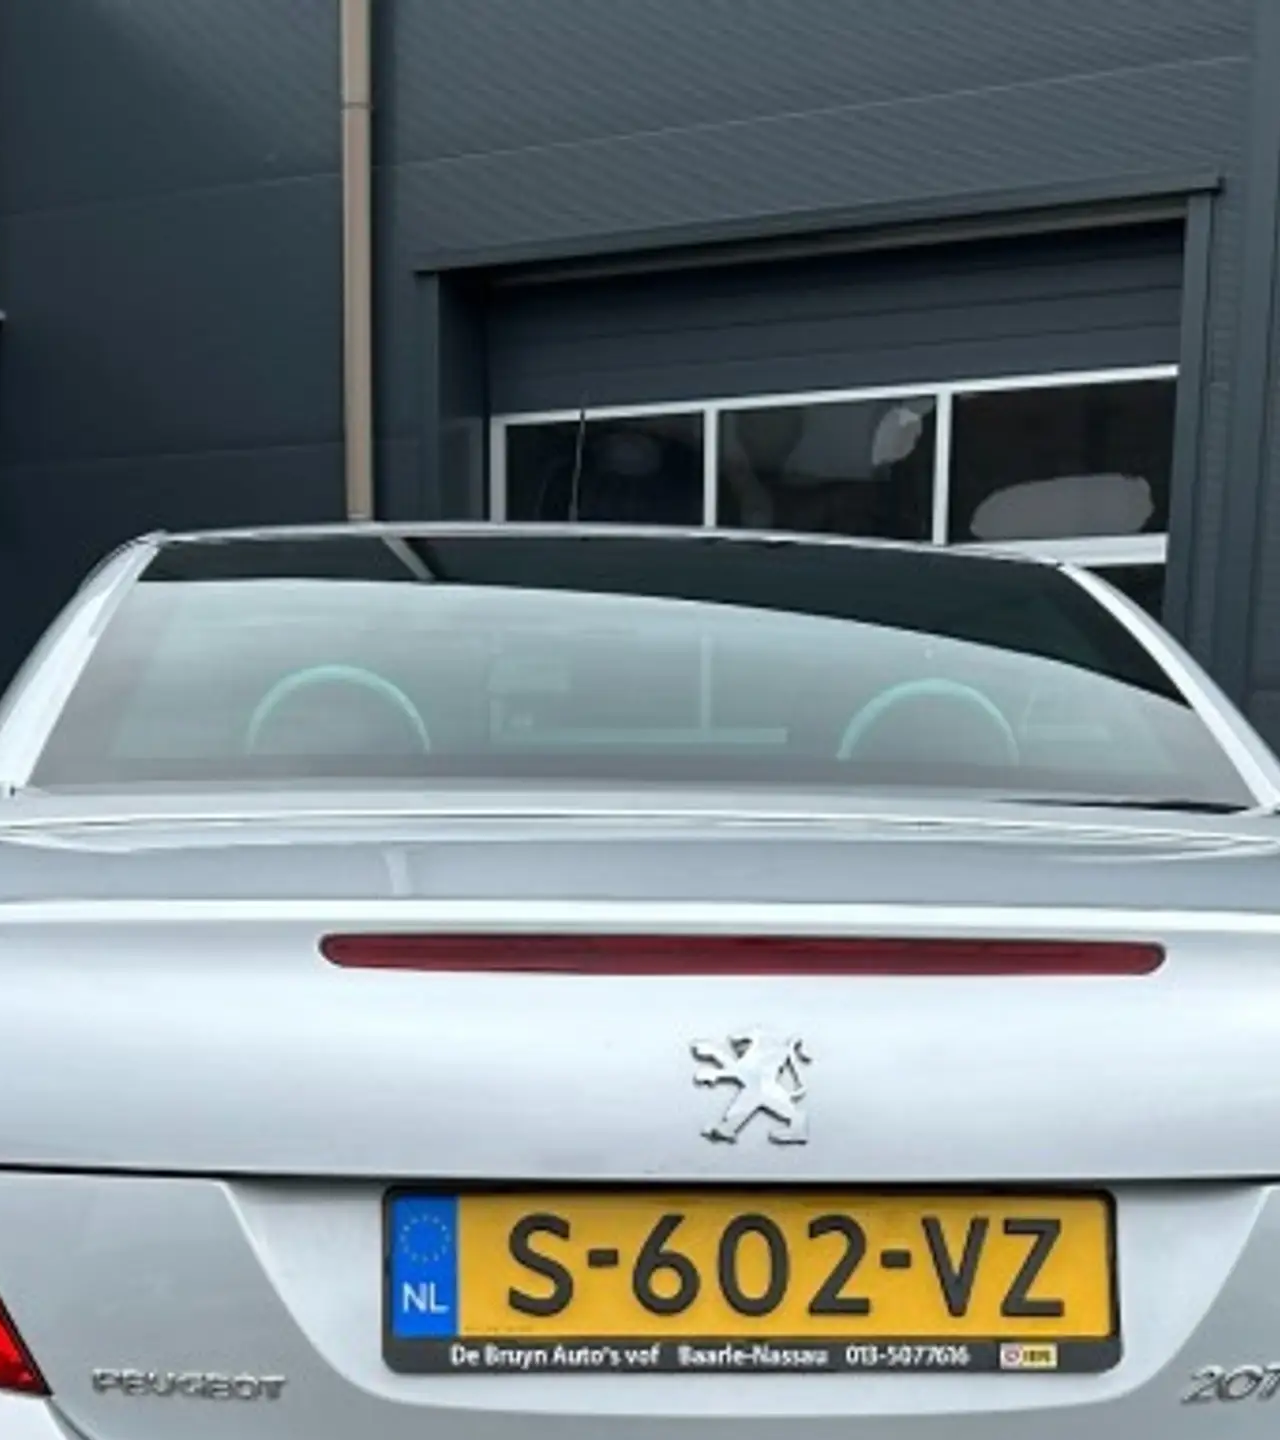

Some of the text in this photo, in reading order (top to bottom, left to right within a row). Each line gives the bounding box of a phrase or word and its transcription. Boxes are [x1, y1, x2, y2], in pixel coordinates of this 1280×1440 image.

[508, 1212, 1065, 1318] S-602-VZ
[402, 1281, 450, 1314] NL
[450, 1343, 480, 1366] De
[484, 1343, 547, 1370] Bruyn
[551, 1343, 620, 1366] Auto's
[623, 1343, 661, 1366] vof
[677, 1343, 830, 1366] Baarle-Nassau
[92, 1367, 287, 1400] PEUGEOT
